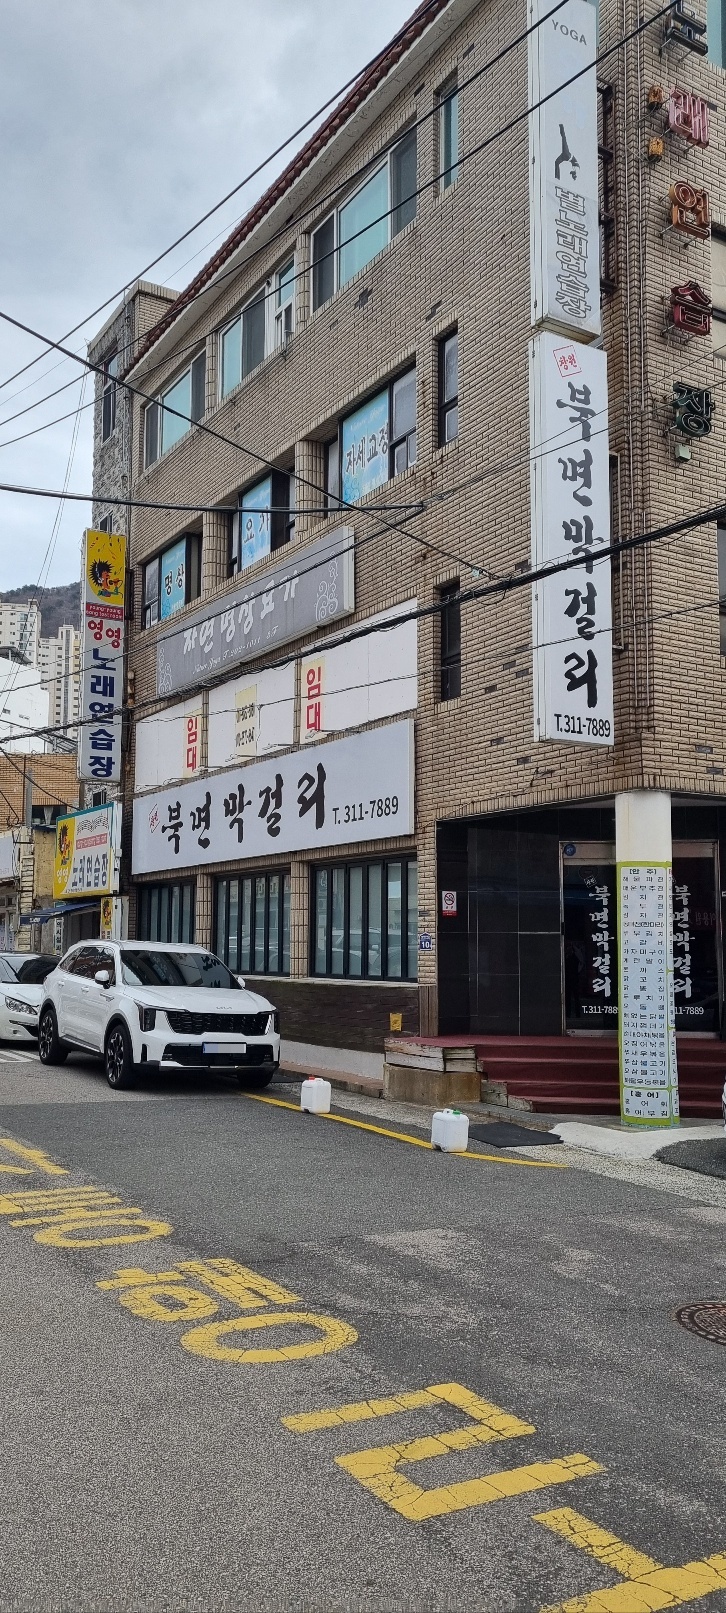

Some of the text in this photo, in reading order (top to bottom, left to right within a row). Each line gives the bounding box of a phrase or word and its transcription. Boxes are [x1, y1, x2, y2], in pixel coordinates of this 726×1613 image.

[551, 19, 587, 46] YOGA
[556, 381, 604, 709] 북면막걸리
[87, 619, 121, 649] 영영
[88, 648, 117, 778] 노래연습장
[306, 666, 322, 732] 임대
[186, 717, 198, 773] 임대
[162, 762, 327, 854] 북면막걸리
[71, 851, 109, 888] 노래연습장
[421, 941, 430, 949] 10
[589, 885, 615, 997] 북면막걸리
[674, 1006, 704, 1015] 11-7889
